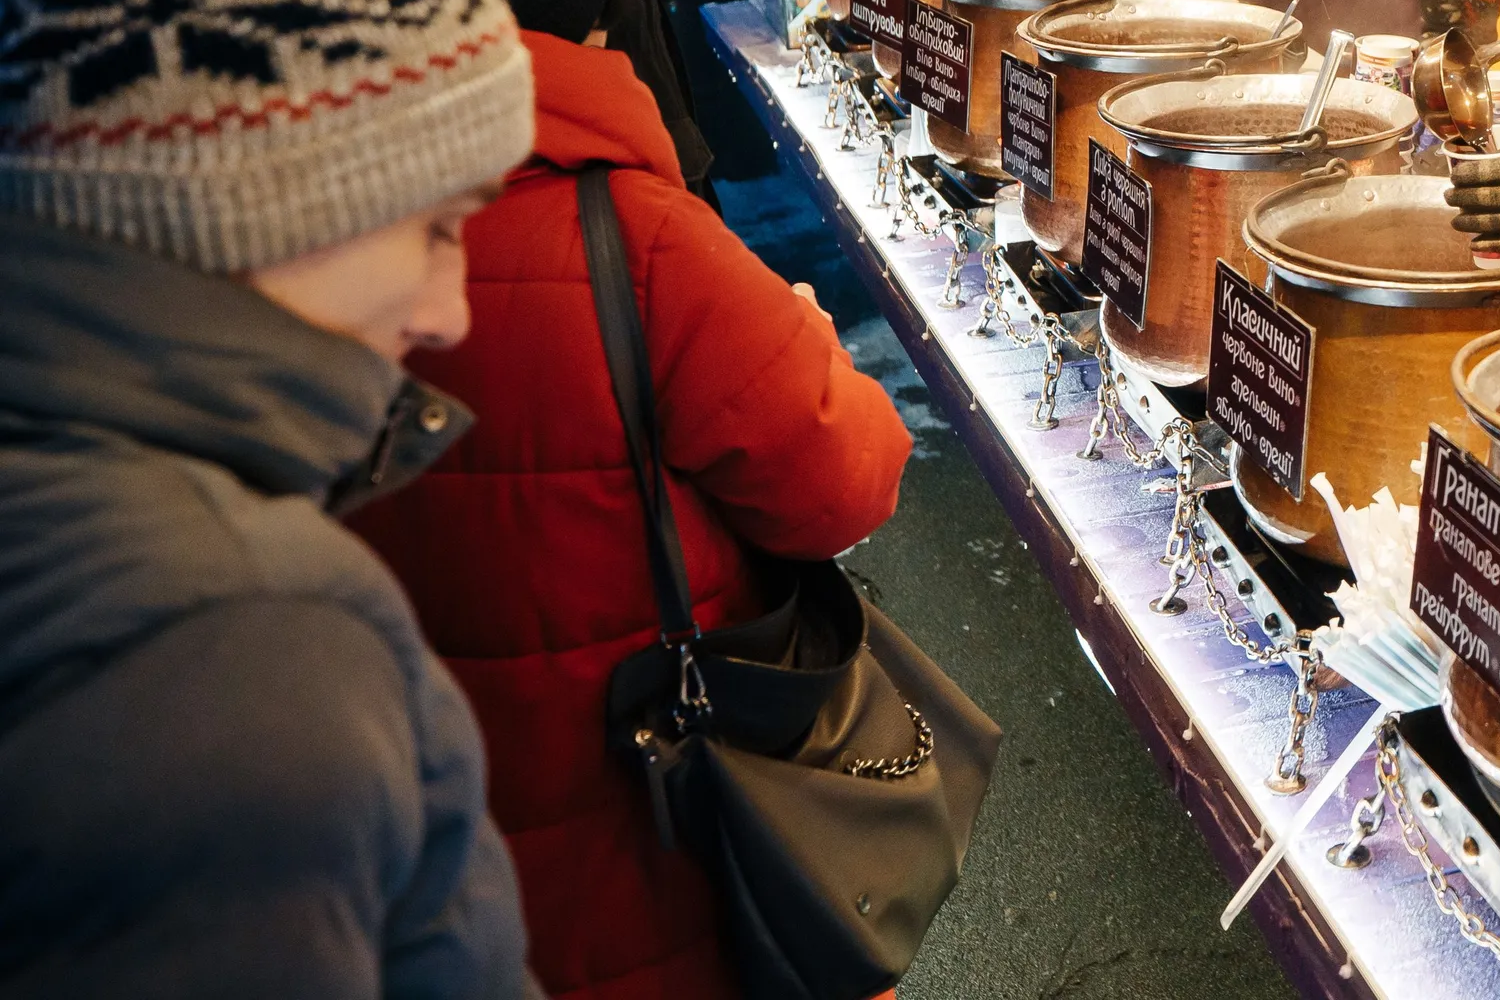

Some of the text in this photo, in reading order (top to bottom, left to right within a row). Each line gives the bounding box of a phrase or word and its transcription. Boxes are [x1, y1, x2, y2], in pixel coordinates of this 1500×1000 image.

[909, 23, 964, 63] обліпиховий
[916, 4, 959, 38] Імбирно-
[906, 60, 961, 102] імбир обліпиха
[917, 48, 954, 79] біле вино
[1222, 280, 1301, 371] Класичний
[1222, 331, 1295, 405] червоне вино
[1231, 375, 1280, 431] апельсин
[1215, 396, 1294, 479] яблуко спеції
[1429, 507, 1500, 586] гранатове
[1415, 581, 1489, 670] грейпфрут
